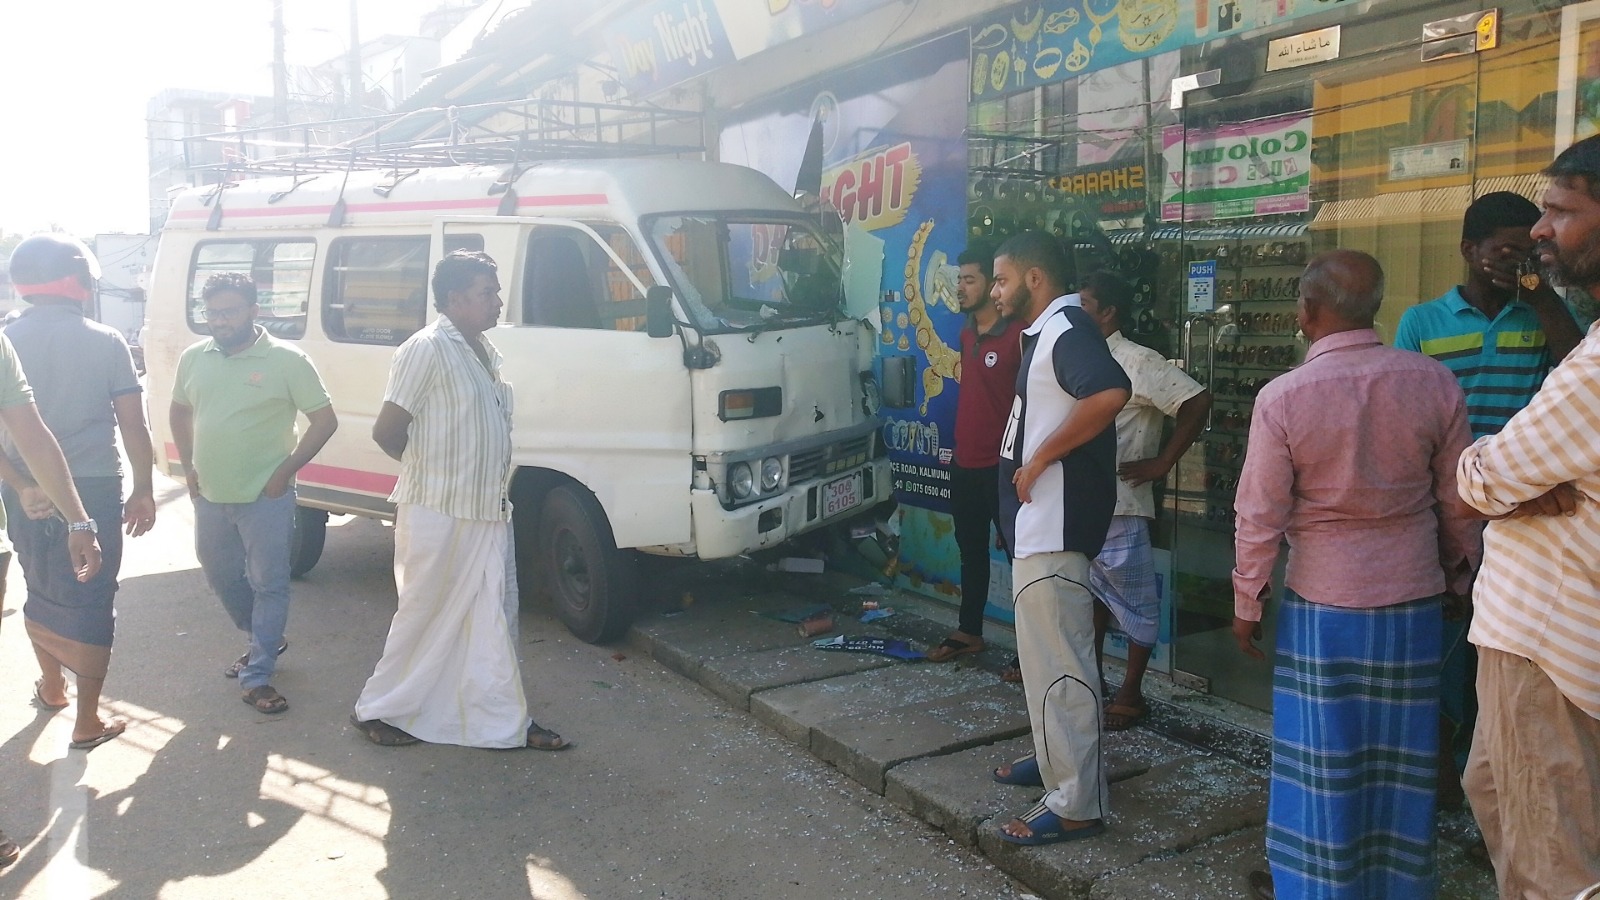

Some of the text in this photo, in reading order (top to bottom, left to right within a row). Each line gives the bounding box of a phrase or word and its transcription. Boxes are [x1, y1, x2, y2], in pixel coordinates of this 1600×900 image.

[617, 0, 713, 81] Day Night
[1278, 37, 1330, 57] ما شاء الله
[819, 142, 911, 226] GHT
[1191, 265, 1213, 275] PUSH
[901, 463, 918, 477] ROAD,
[912, 483, 923, 494] 075
[939, 488, 951, 499] 401
[828, 493, 856, 512] 6105
